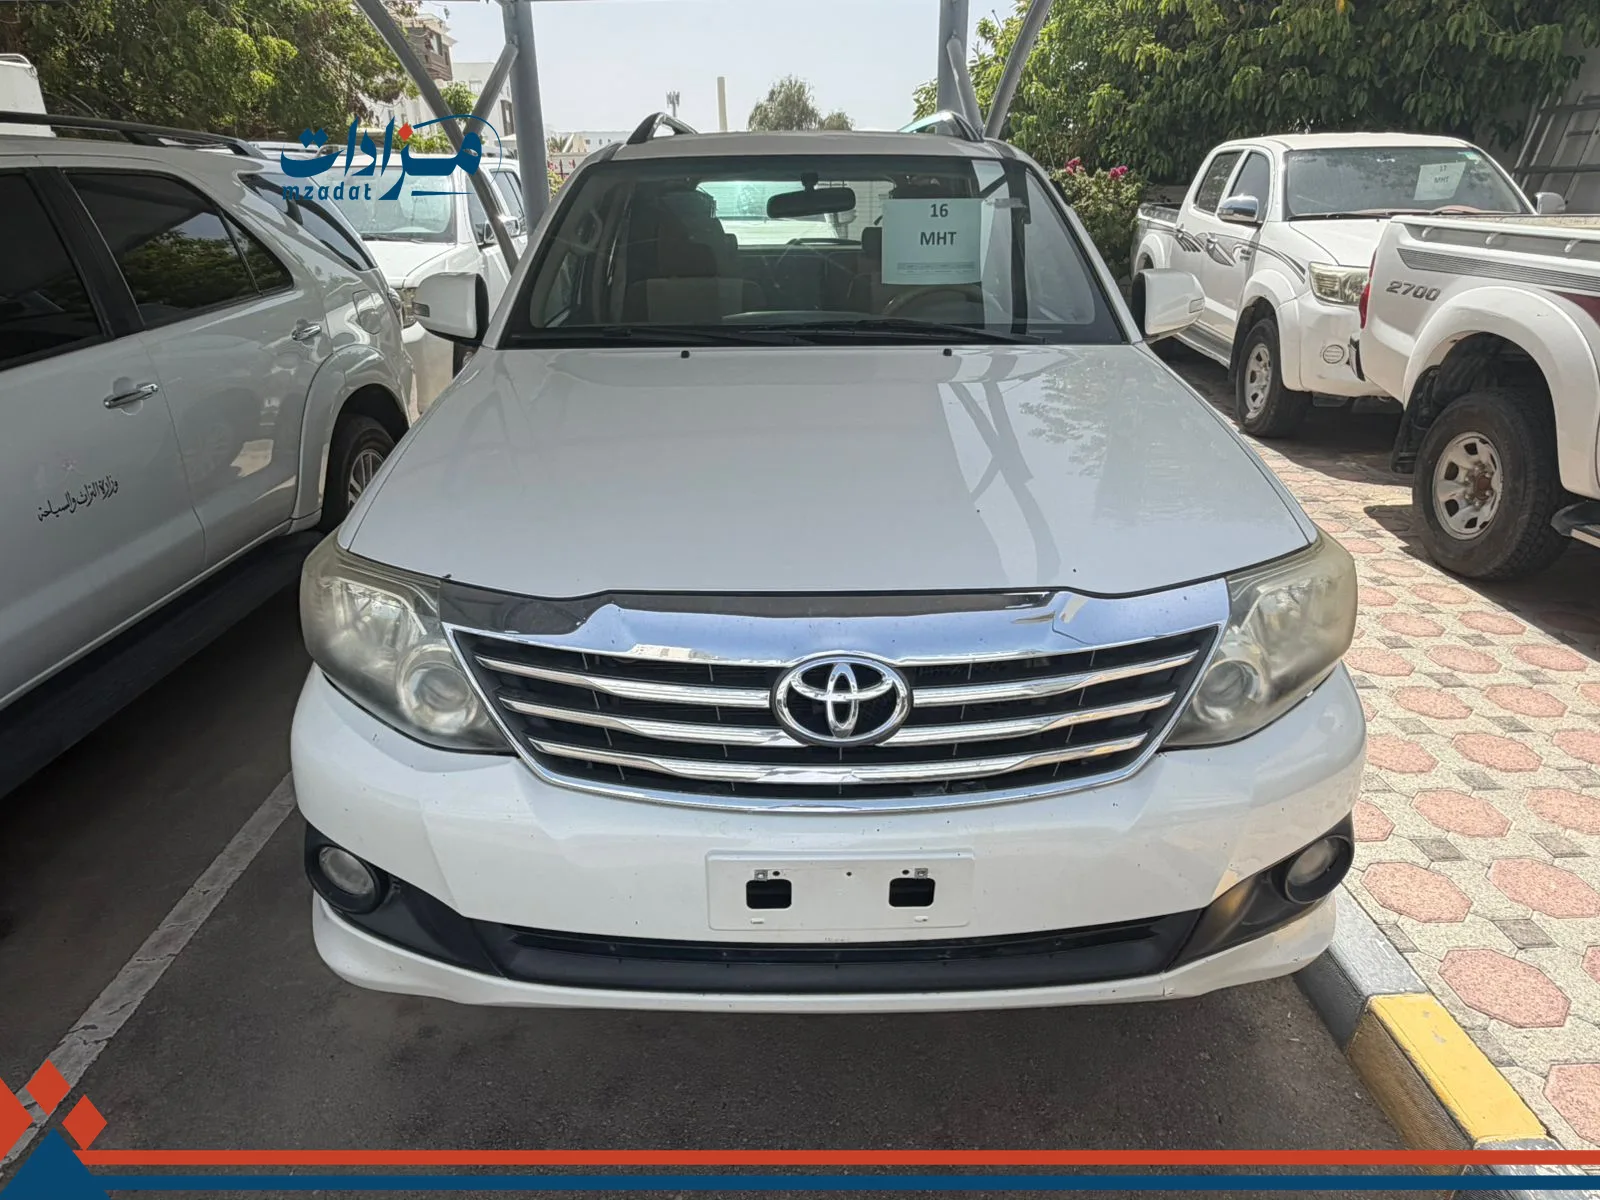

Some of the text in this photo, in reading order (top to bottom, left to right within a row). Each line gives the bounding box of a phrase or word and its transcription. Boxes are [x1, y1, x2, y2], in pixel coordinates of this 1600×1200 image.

[930, 203, 949, 218] 16
[920, 231, 957, 246] MHT
[1386, 280, 1442, 301] 2700
[37, 474, 119, 522] وزارة التراث والسياحة
